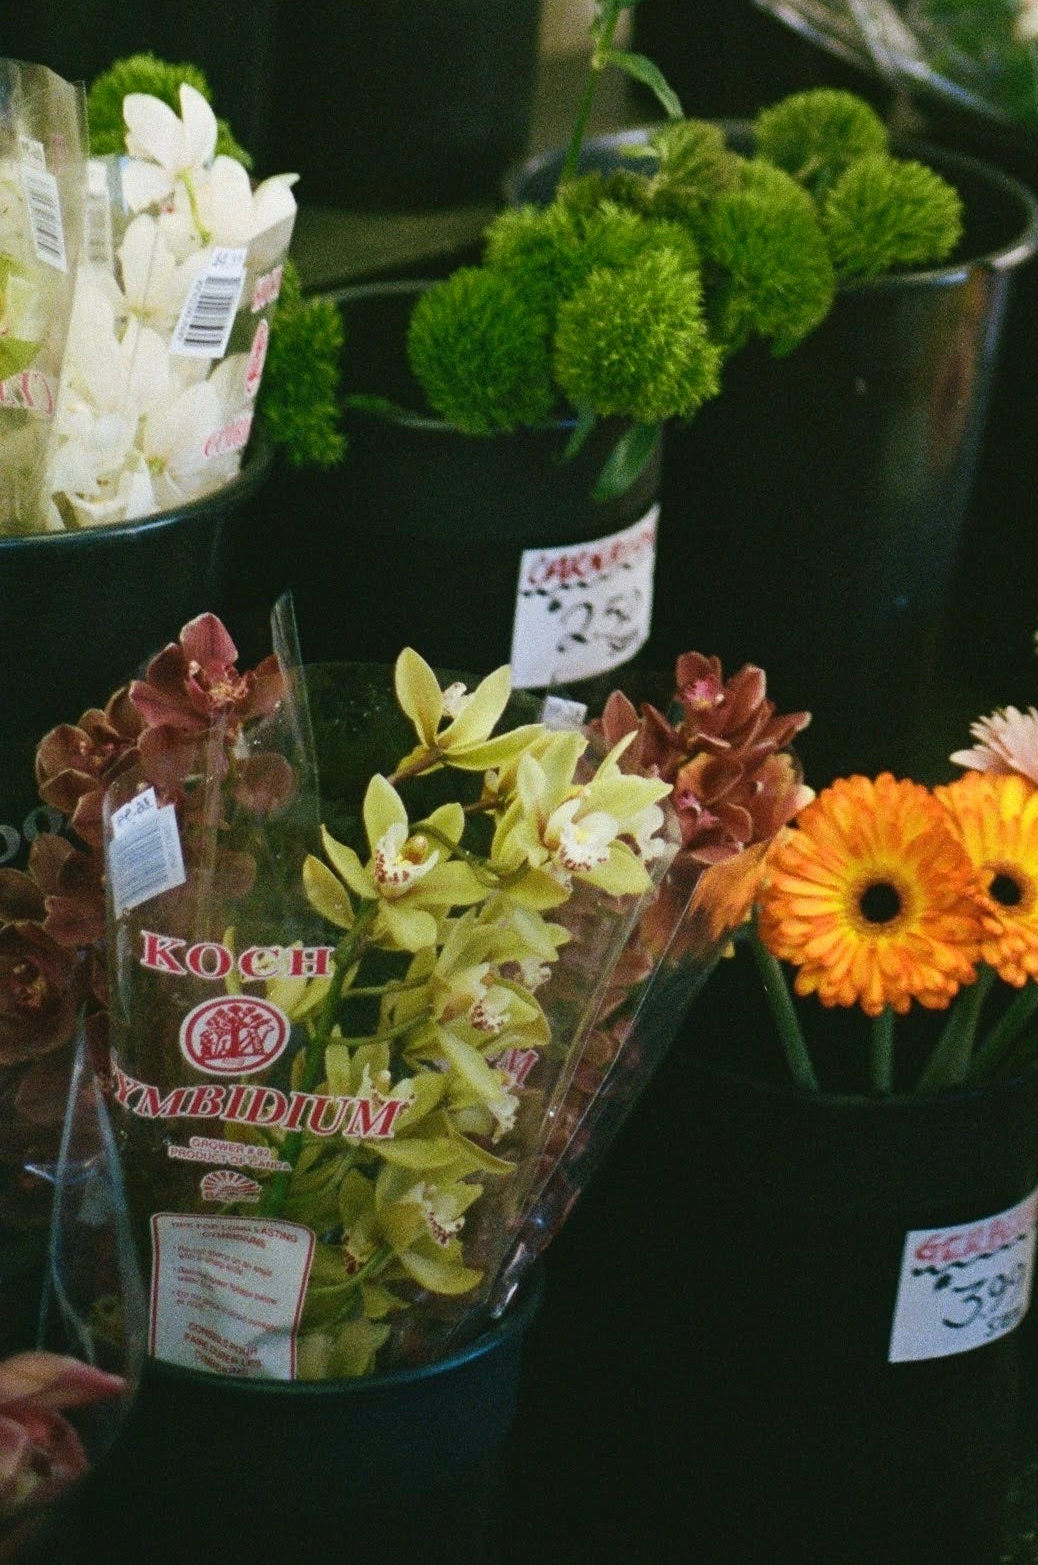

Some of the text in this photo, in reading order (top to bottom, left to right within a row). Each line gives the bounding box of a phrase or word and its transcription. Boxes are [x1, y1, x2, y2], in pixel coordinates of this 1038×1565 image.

[141, 930, 334, 981] KOCH
[113, 1067, 404, 1138] YMBIDIUM
[169, 1146, 228, 1162] PRODUCT
